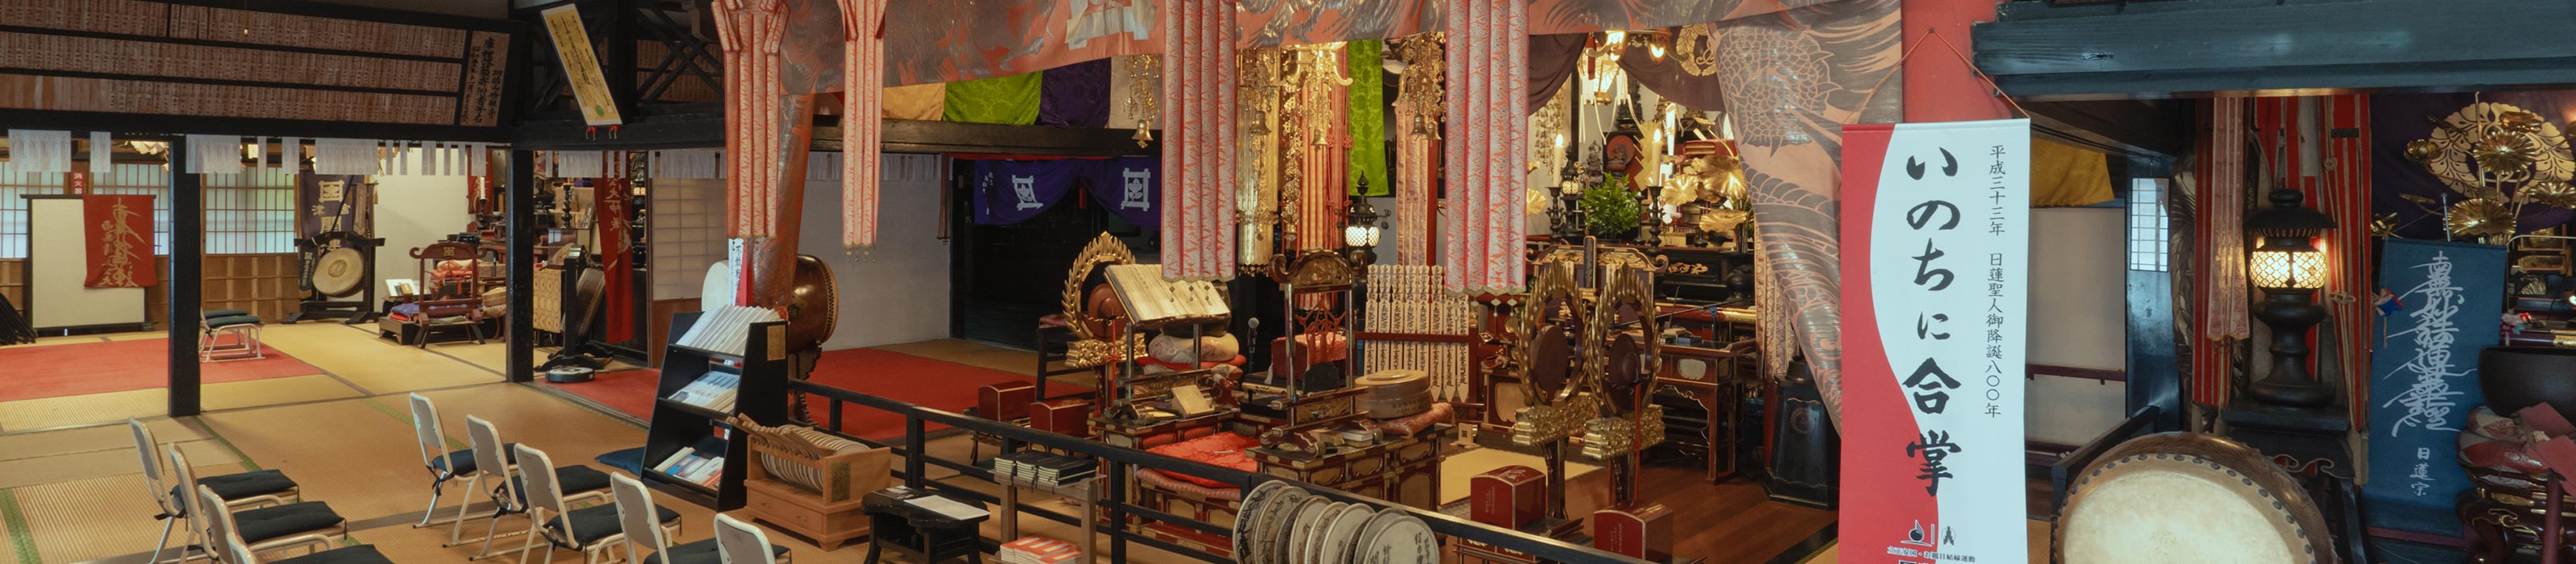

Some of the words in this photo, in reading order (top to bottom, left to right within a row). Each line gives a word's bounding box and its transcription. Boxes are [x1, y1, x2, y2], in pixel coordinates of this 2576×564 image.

[1988, 145, 2006, 236] 平成三十三年
[1902, 147, 1962, 497] いのちに合掌
[2409, 447, 2435, 497] 日蓮宗
